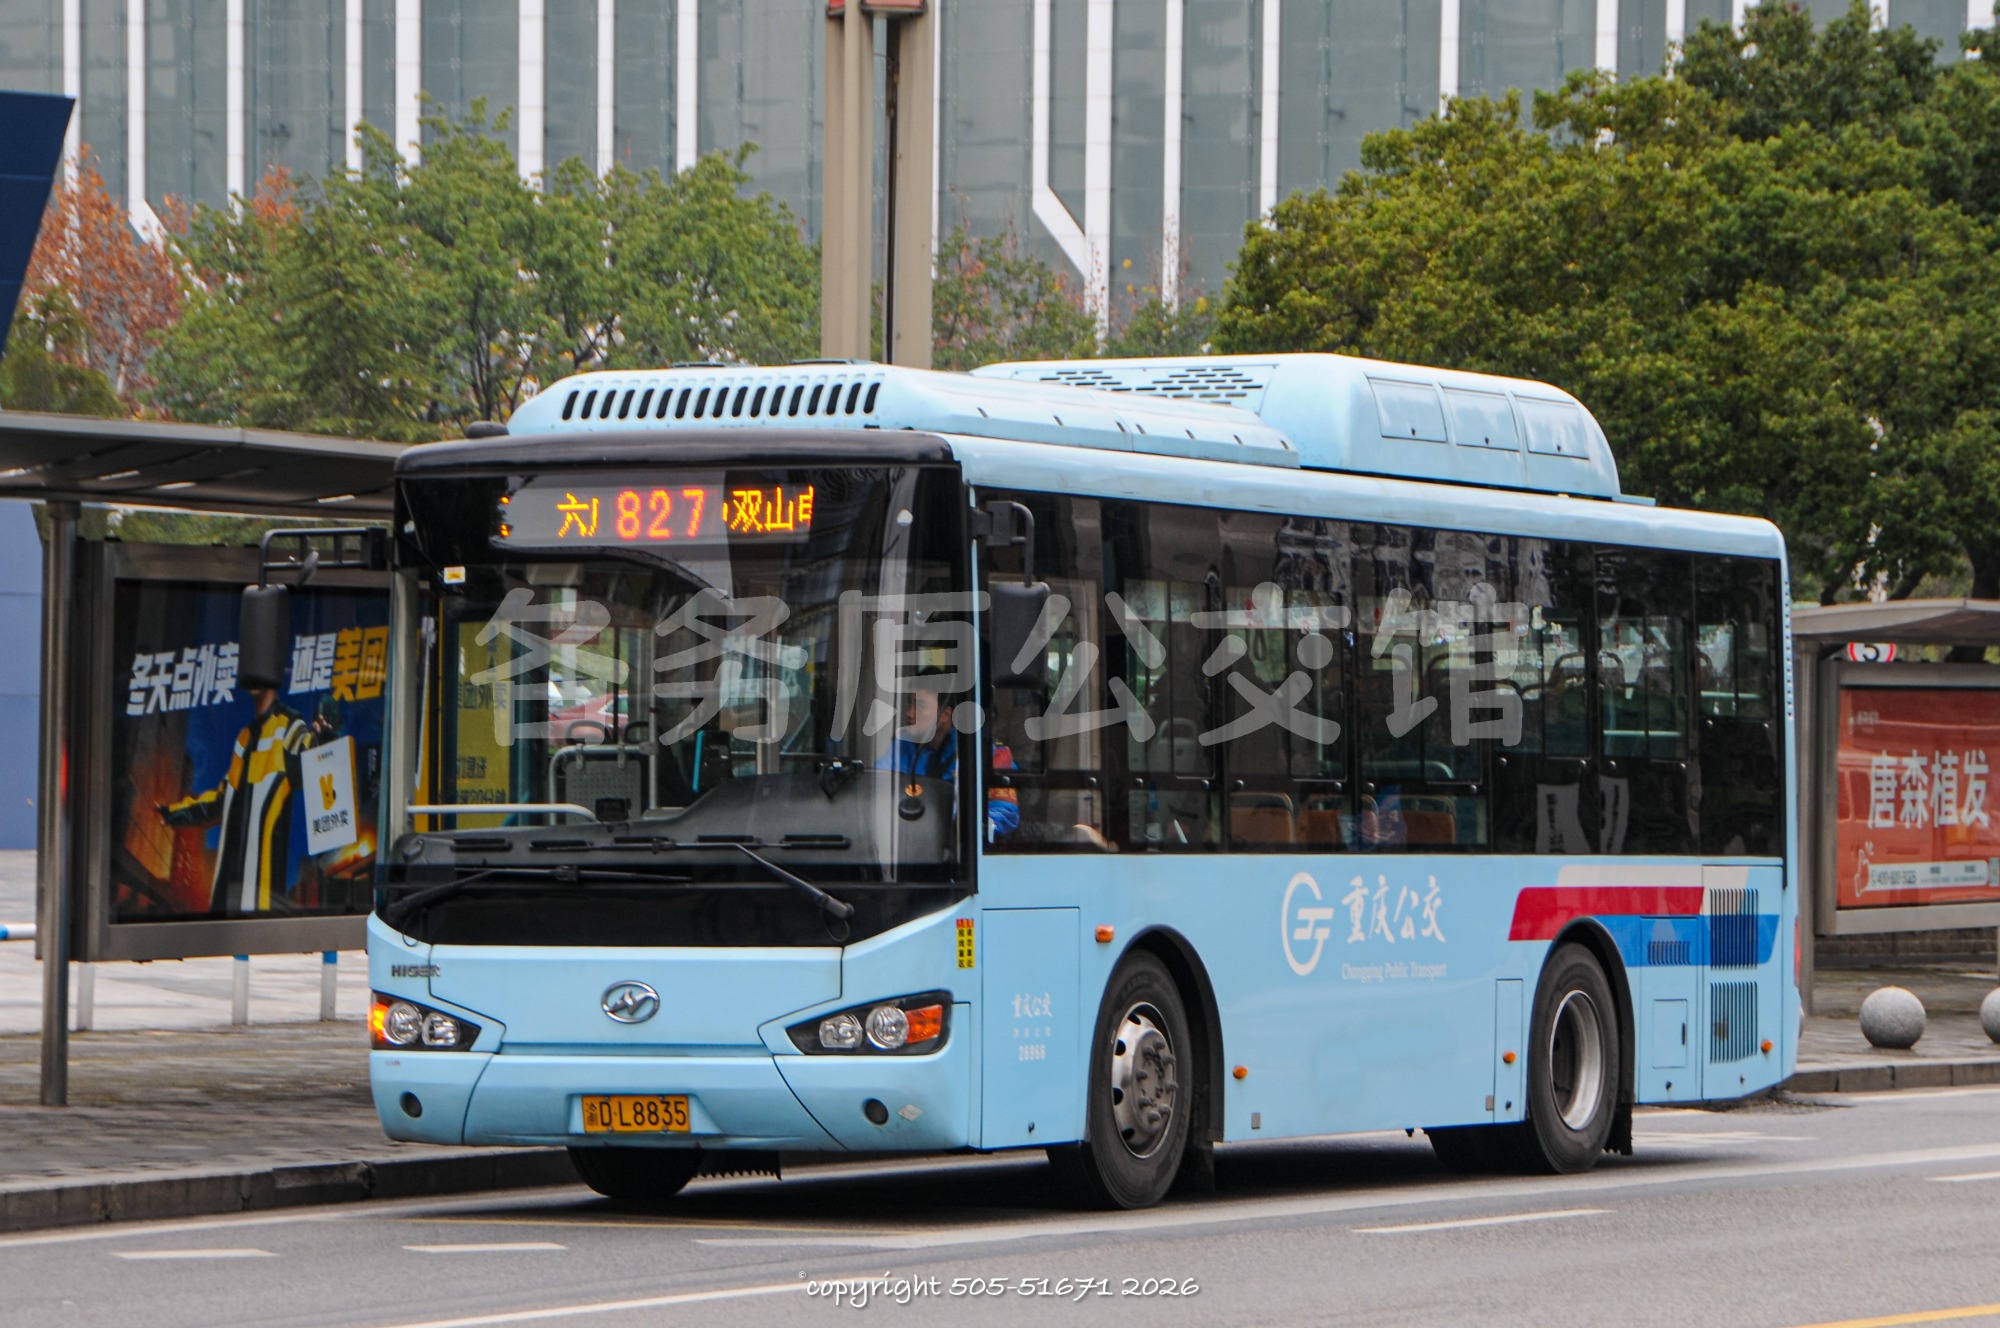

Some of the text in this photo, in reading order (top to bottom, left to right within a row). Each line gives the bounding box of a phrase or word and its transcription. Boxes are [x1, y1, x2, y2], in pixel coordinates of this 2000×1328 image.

[616, 488, 705, 539] 827
[126, 641, 240, 716] 冬天点外卖
[1867, 749, 1989, 830] 唐森植发
[1341, 874, 1447, 945] 重庆公交
[391, 963, 442, 978] HIGER
